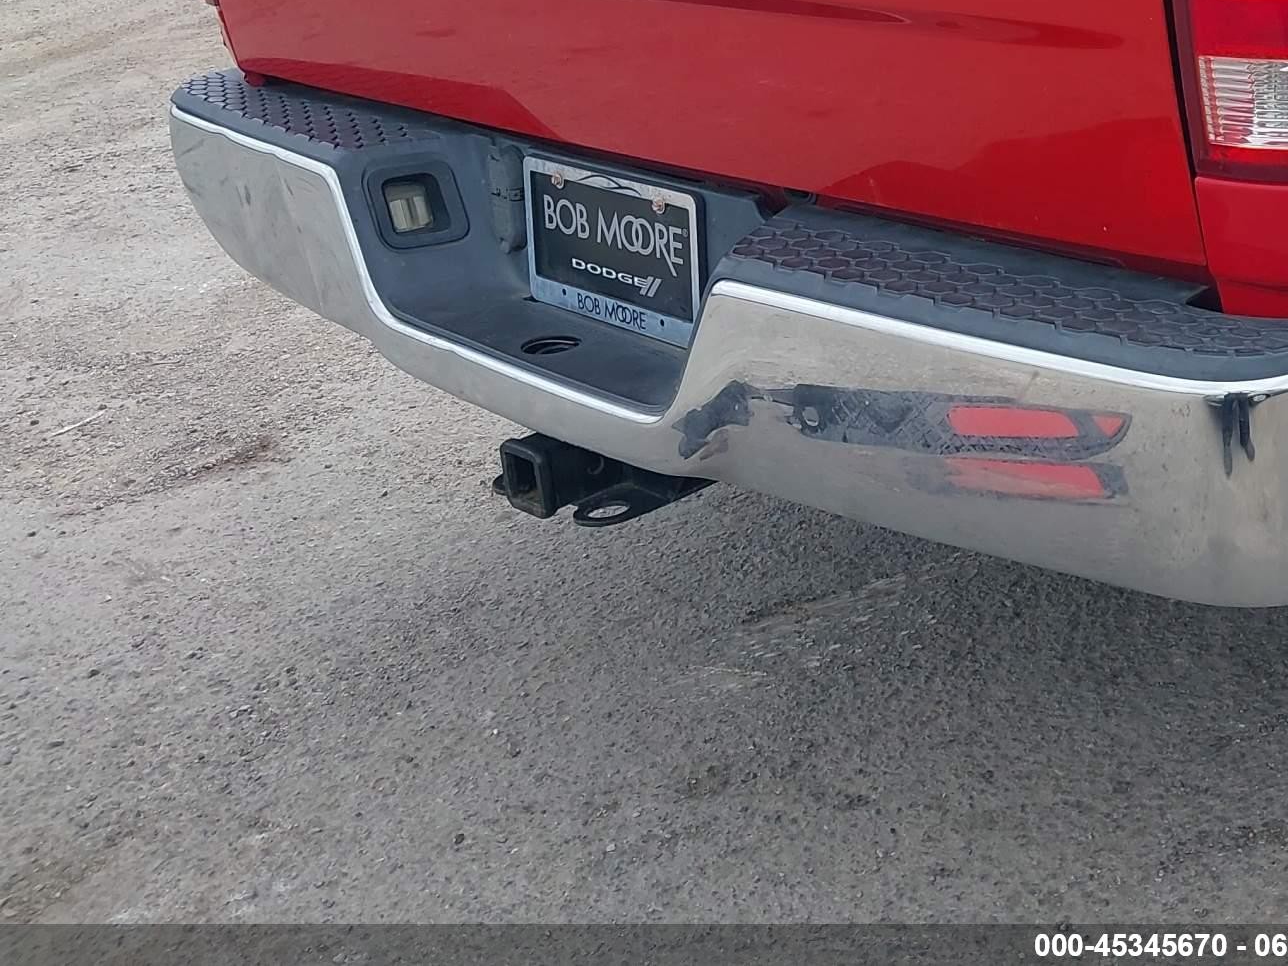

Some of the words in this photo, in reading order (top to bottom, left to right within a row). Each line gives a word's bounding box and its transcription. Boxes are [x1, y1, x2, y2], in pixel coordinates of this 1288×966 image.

[543, 194, 590, 239] BOB
[596, 207, 684, 277] MOORE
[571, 257, 648, 287] DODGE
[577, 293, 601, 315] BOB
[604, 301, 646, 330] MOORE
